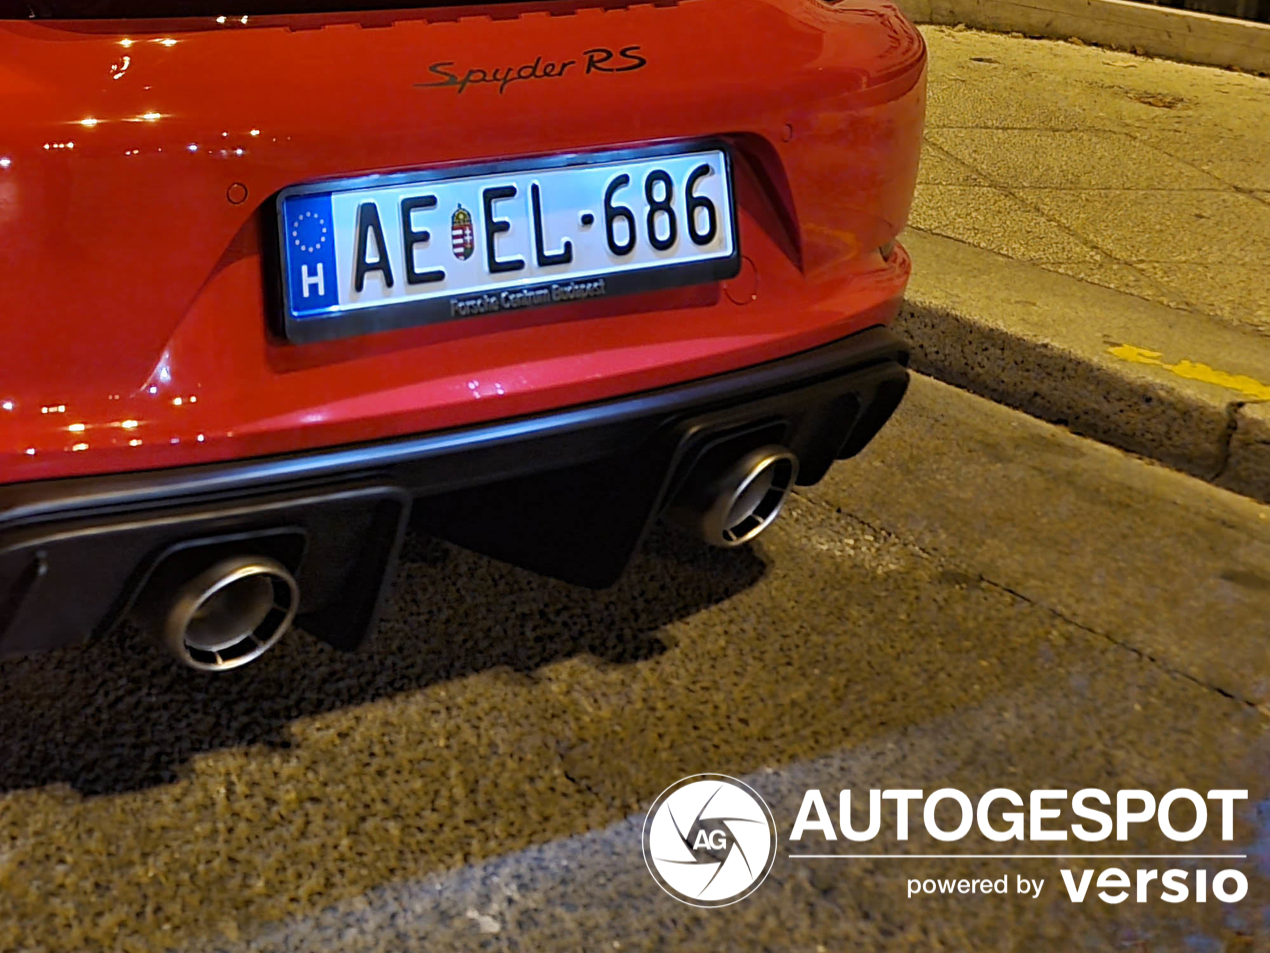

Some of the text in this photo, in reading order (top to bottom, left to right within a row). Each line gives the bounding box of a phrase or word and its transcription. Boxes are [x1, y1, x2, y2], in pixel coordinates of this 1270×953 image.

[413, 46, 647, 94] Spyder RS
[301, 262, 326, 299] H
